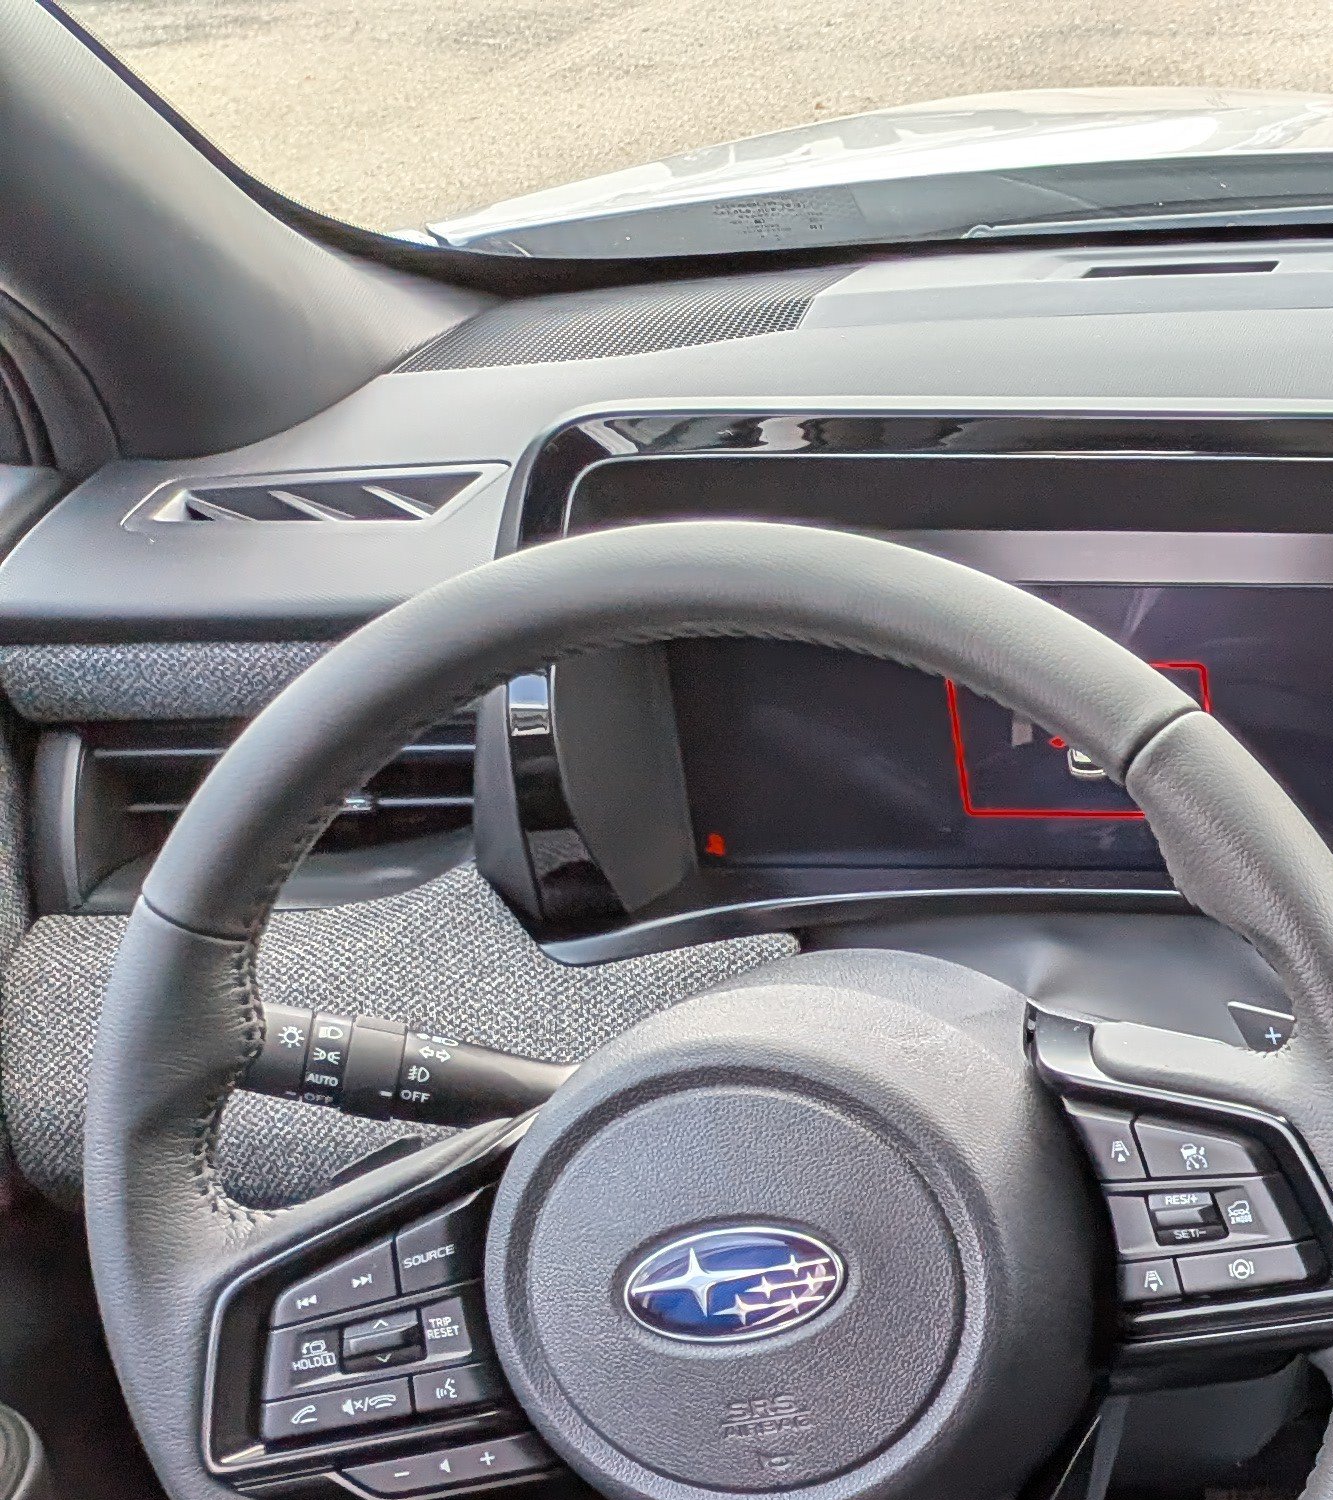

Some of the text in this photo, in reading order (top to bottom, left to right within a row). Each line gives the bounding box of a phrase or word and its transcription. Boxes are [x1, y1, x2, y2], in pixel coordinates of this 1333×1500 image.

[305, 1070, 338, 1088] AUTO
[400, 1089, 431, 1103] OFF
[403, 1243, 455, 1269] SOURCE
[428, 1316, 452, 1328] TRIP
[426, 1325, 460, 1340] RESET
[726, 1394, 799, 1422] SRS
